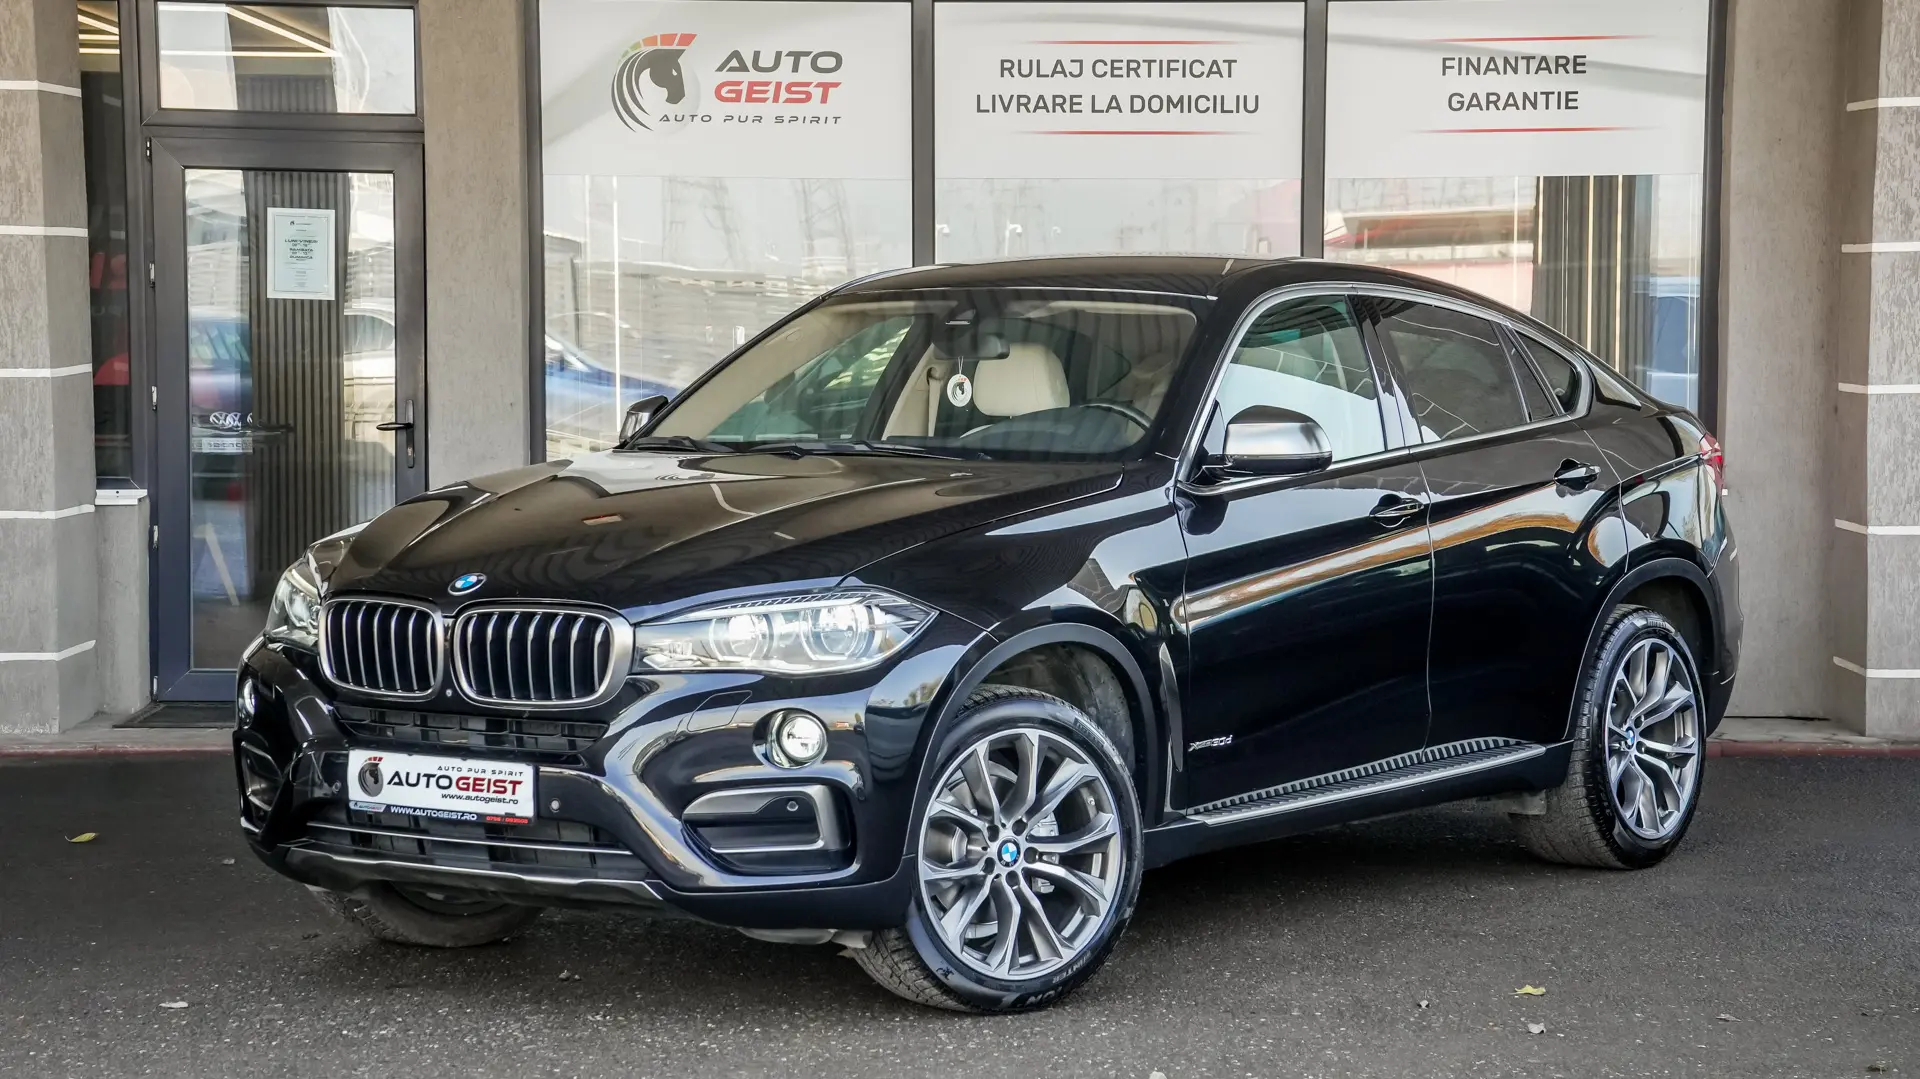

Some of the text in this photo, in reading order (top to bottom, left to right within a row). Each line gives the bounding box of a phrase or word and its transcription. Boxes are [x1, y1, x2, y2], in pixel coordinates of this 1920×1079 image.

[714, 49, 843, 73] AUTO
[999, 58, 1238, 79] RULAJ CERTIFICAT
[1441, 54, 1588, 77] FINANTARE
[713, 80, 843, 105] GEIST
[1447, 90, 1580, 112] GARANTIE
[975, 93, 1260, 114] LIVRARE LA DOMICILIU
[659, 113, 843, 125] AUTO PUR SPIRIT
[437, 765, 463, 773] AUTO
[491, 769, 524, 777] SPIRIT
[441, 793, 519, 805] www.autogeist.ro
[390, 805, 478, 821] WWW.AUTOGEIST.RO
